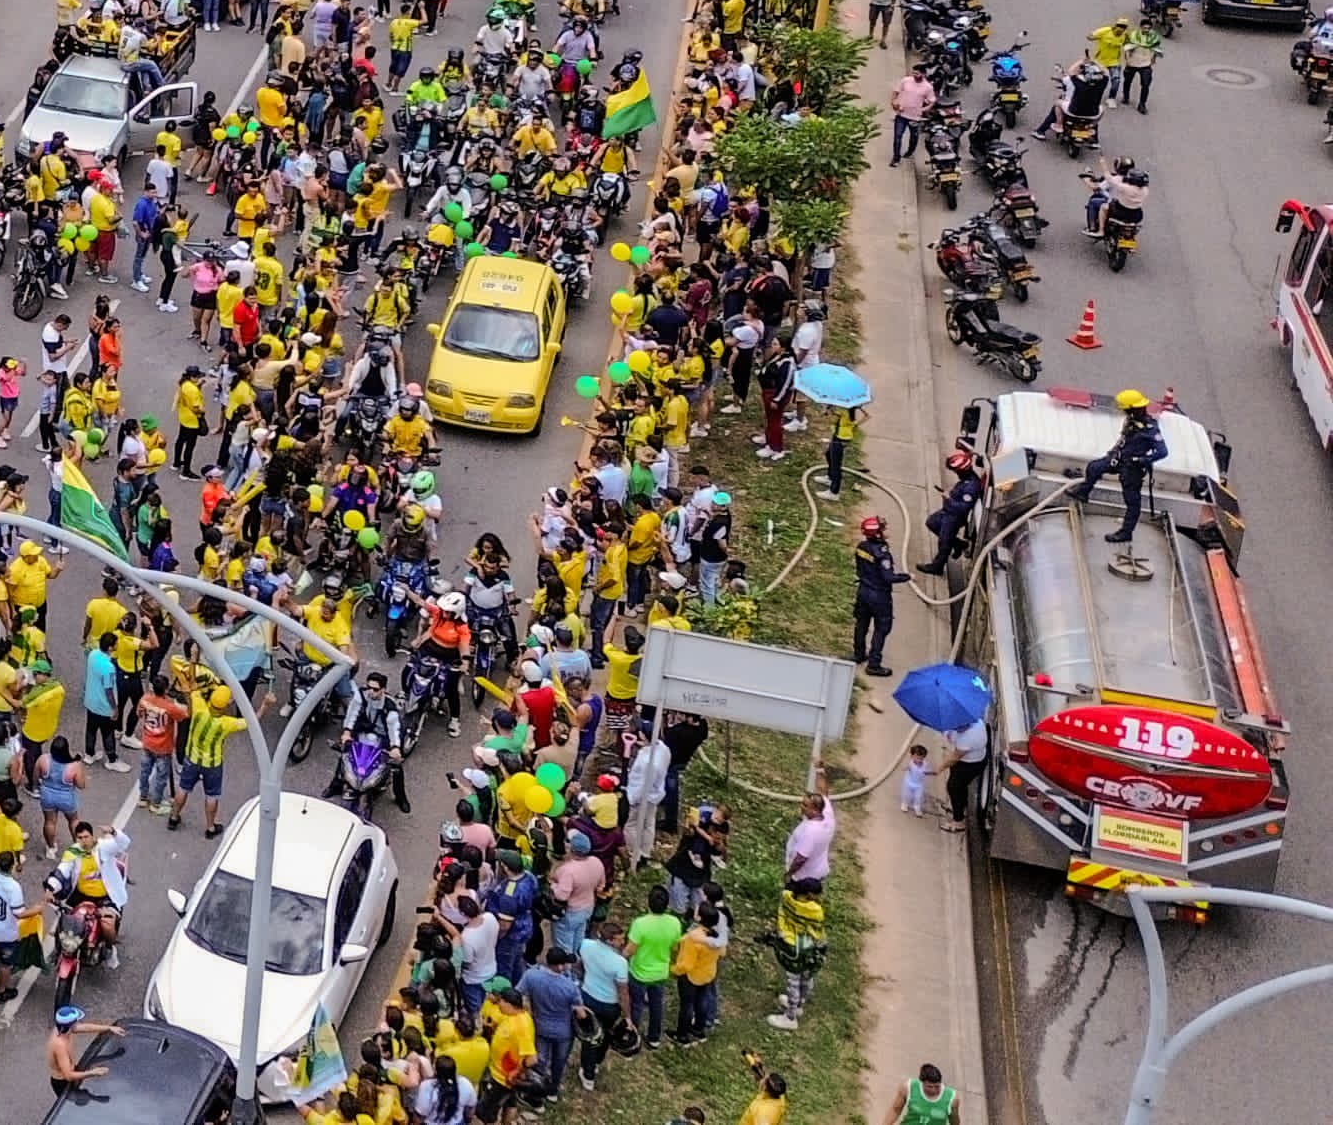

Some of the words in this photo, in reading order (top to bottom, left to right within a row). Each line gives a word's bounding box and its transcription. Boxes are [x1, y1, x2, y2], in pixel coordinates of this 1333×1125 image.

[1118, 717, 1194, 758] 119
[1103, 828, 1177, 848] FLORIDABLANCA
[1116, 823, 1165, 838] BOMBEROS
